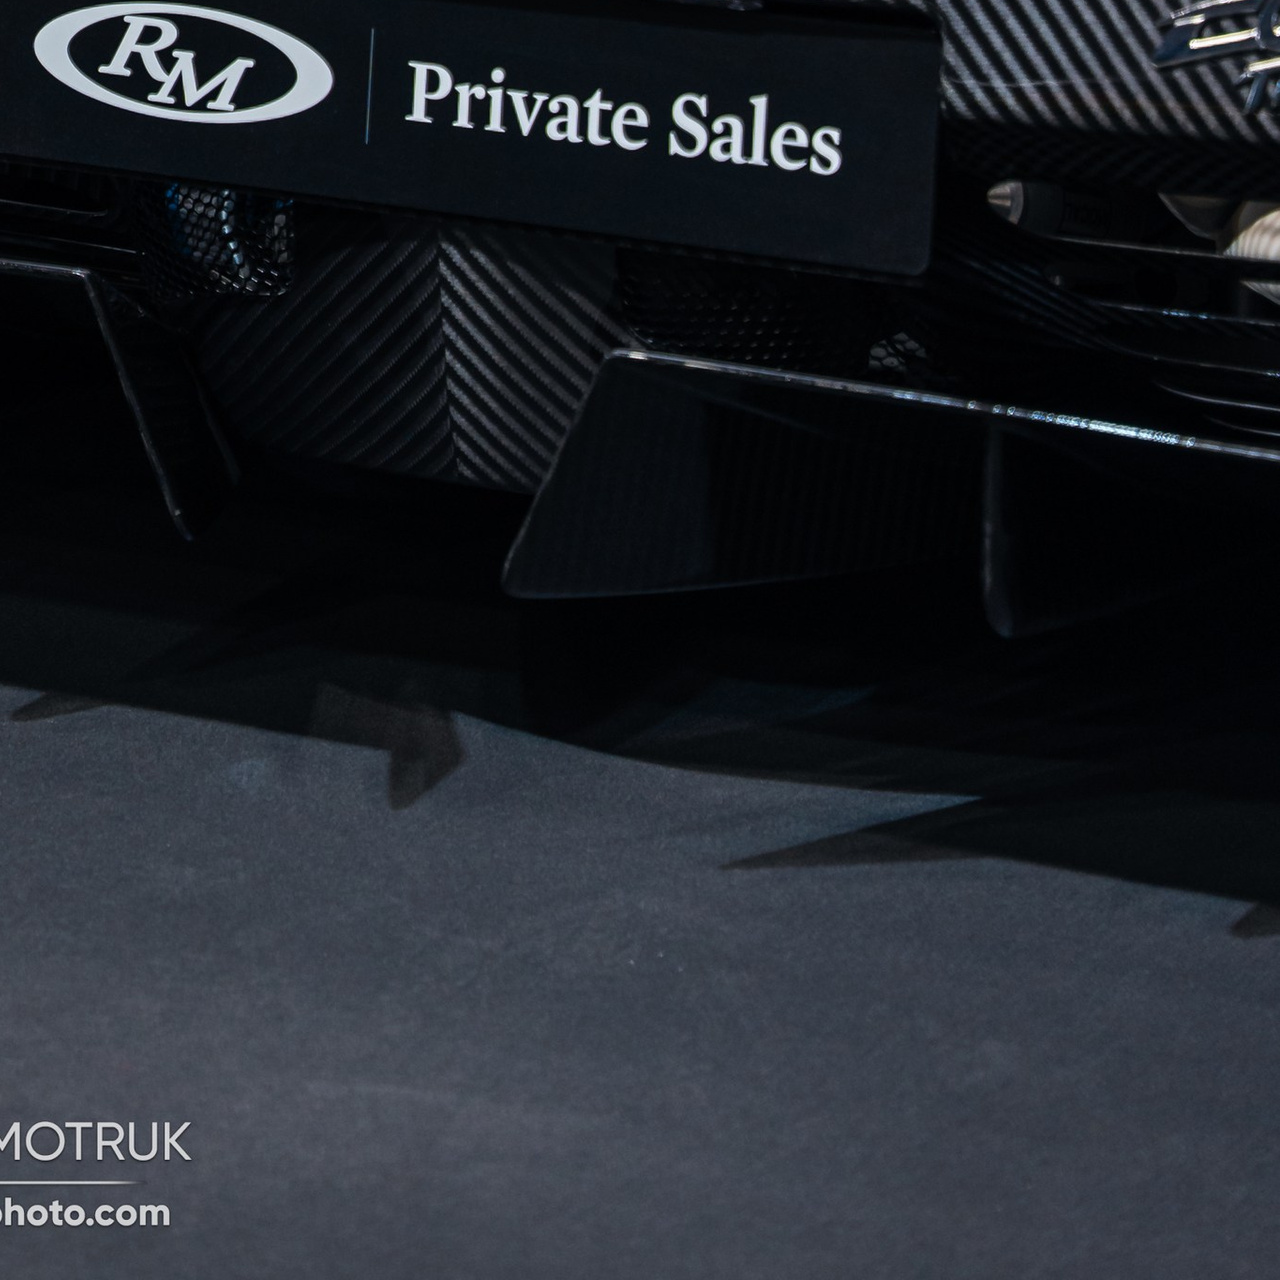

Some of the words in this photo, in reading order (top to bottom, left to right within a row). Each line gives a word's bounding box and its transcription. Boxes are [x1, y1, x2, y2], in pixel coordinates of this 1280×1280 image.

[98, 14, 255, 112] RM
[405, 59, 650, 151] Private
[669, 95, 843, 177] Sales
